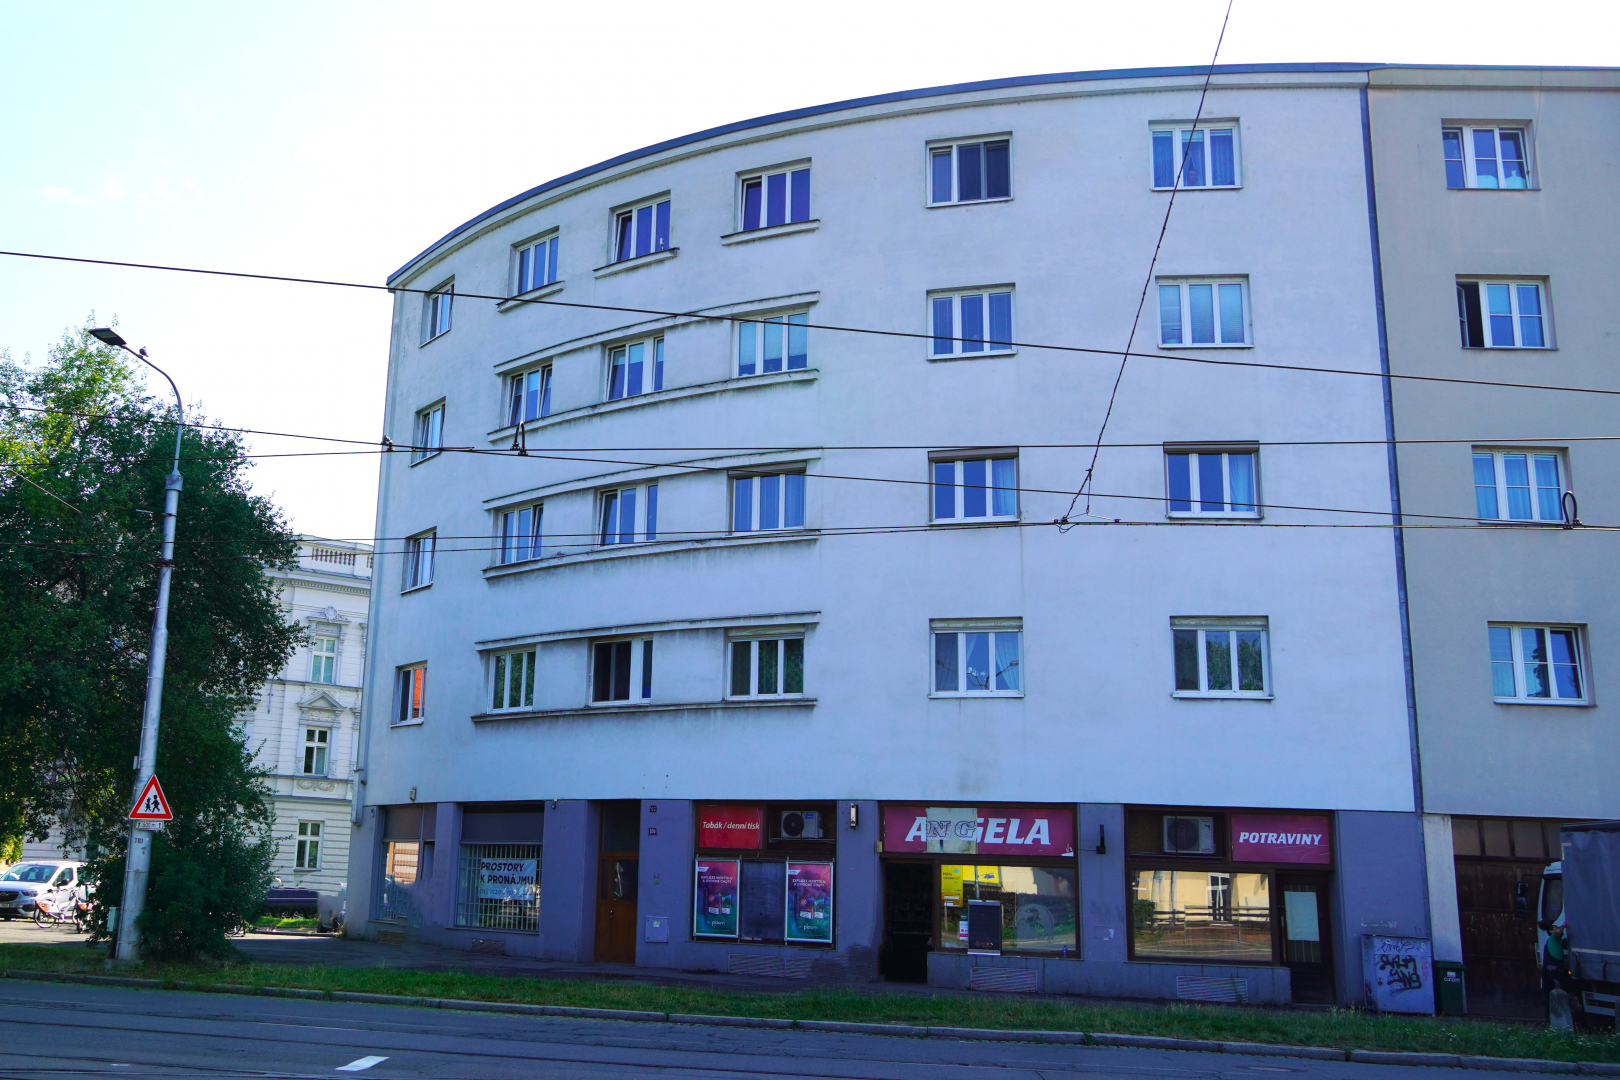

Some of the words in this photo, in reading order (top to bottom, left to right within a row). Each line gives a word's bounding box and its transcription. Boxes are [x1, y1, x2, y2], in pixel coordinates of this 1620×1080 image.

[702, 821, 723, 829] Tabák
[727, 821, 748, 830] denní
[747, 822, 760, 830] tisk
[1239, 831, 1322, 845] POTRAVINY
[481, 862, 525, 872] PROSTORY
[480, 875, 486, 884] K
[487, 874, 533, 885] PRONÁJMU
